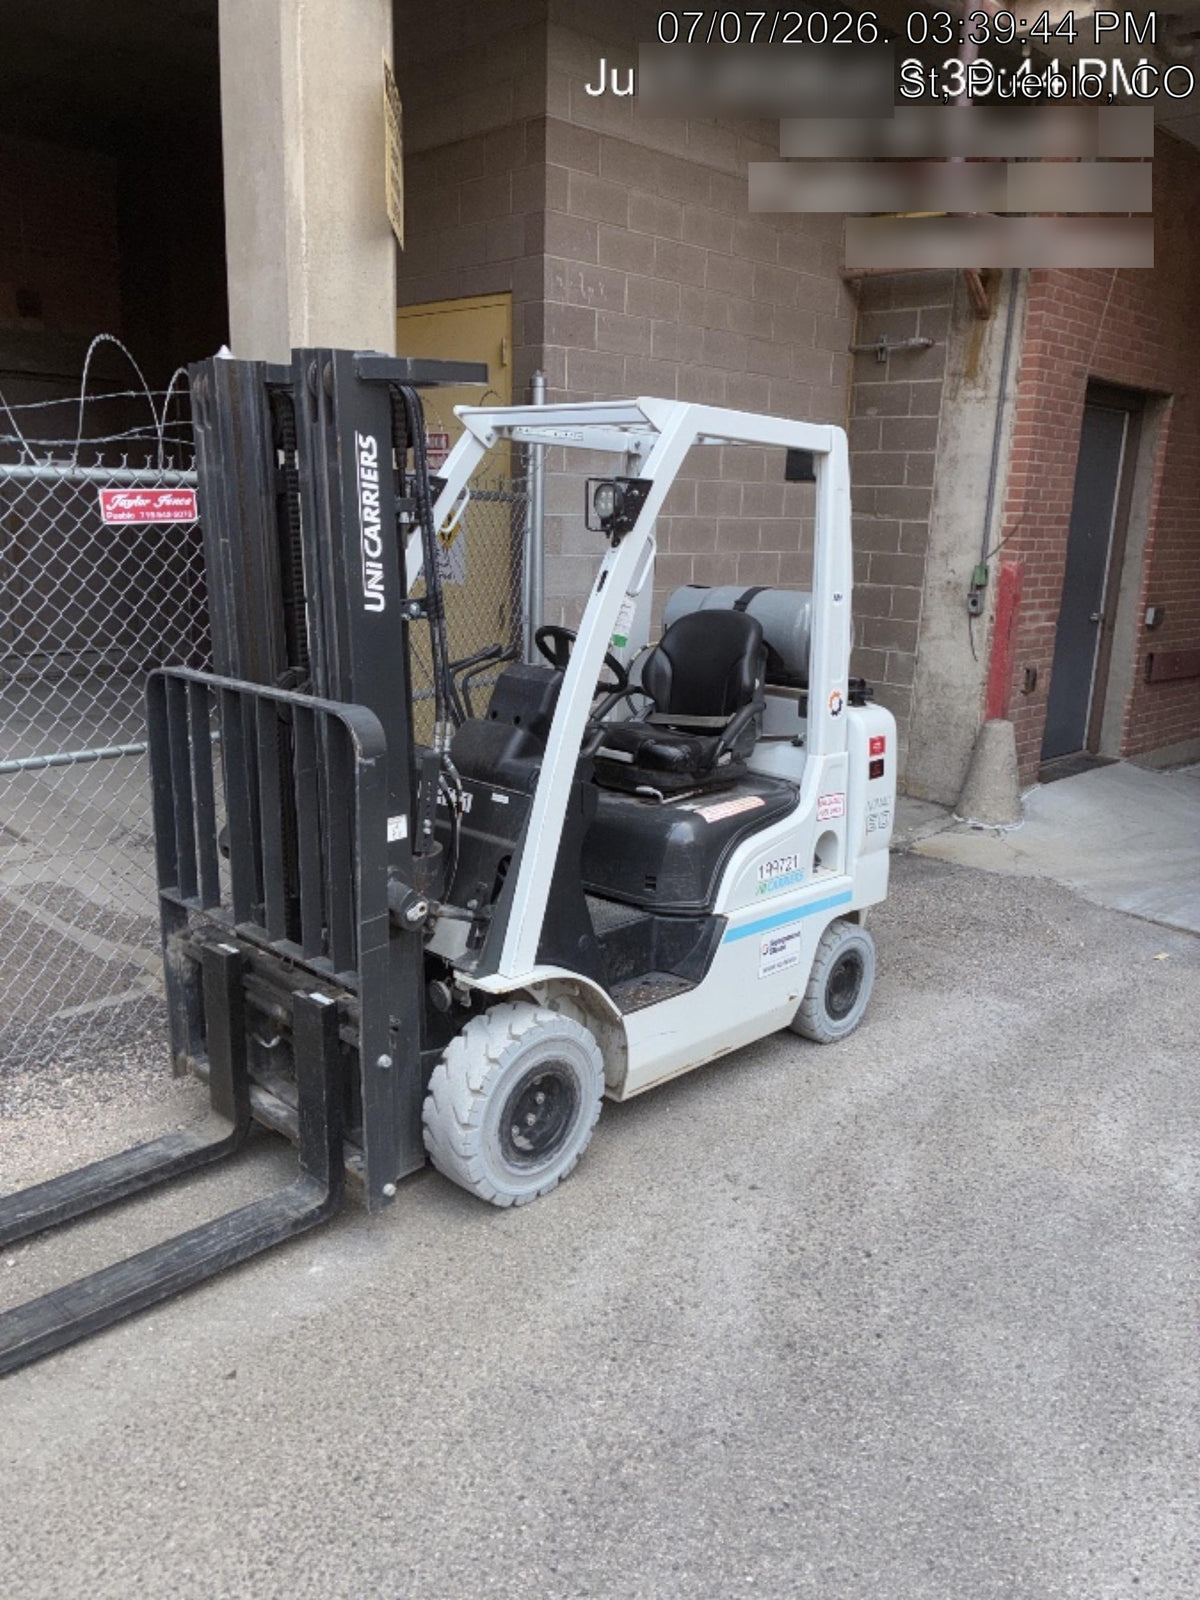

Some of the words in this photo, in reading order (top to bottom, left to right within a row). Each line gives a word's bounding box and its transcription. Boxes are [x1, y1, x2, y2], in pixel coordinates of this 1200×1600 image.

[106, 493, 151, 510] Taylor
[153, 493, 192, 509] Fence
[355, 431, 386, 612] UNICARRIERS
